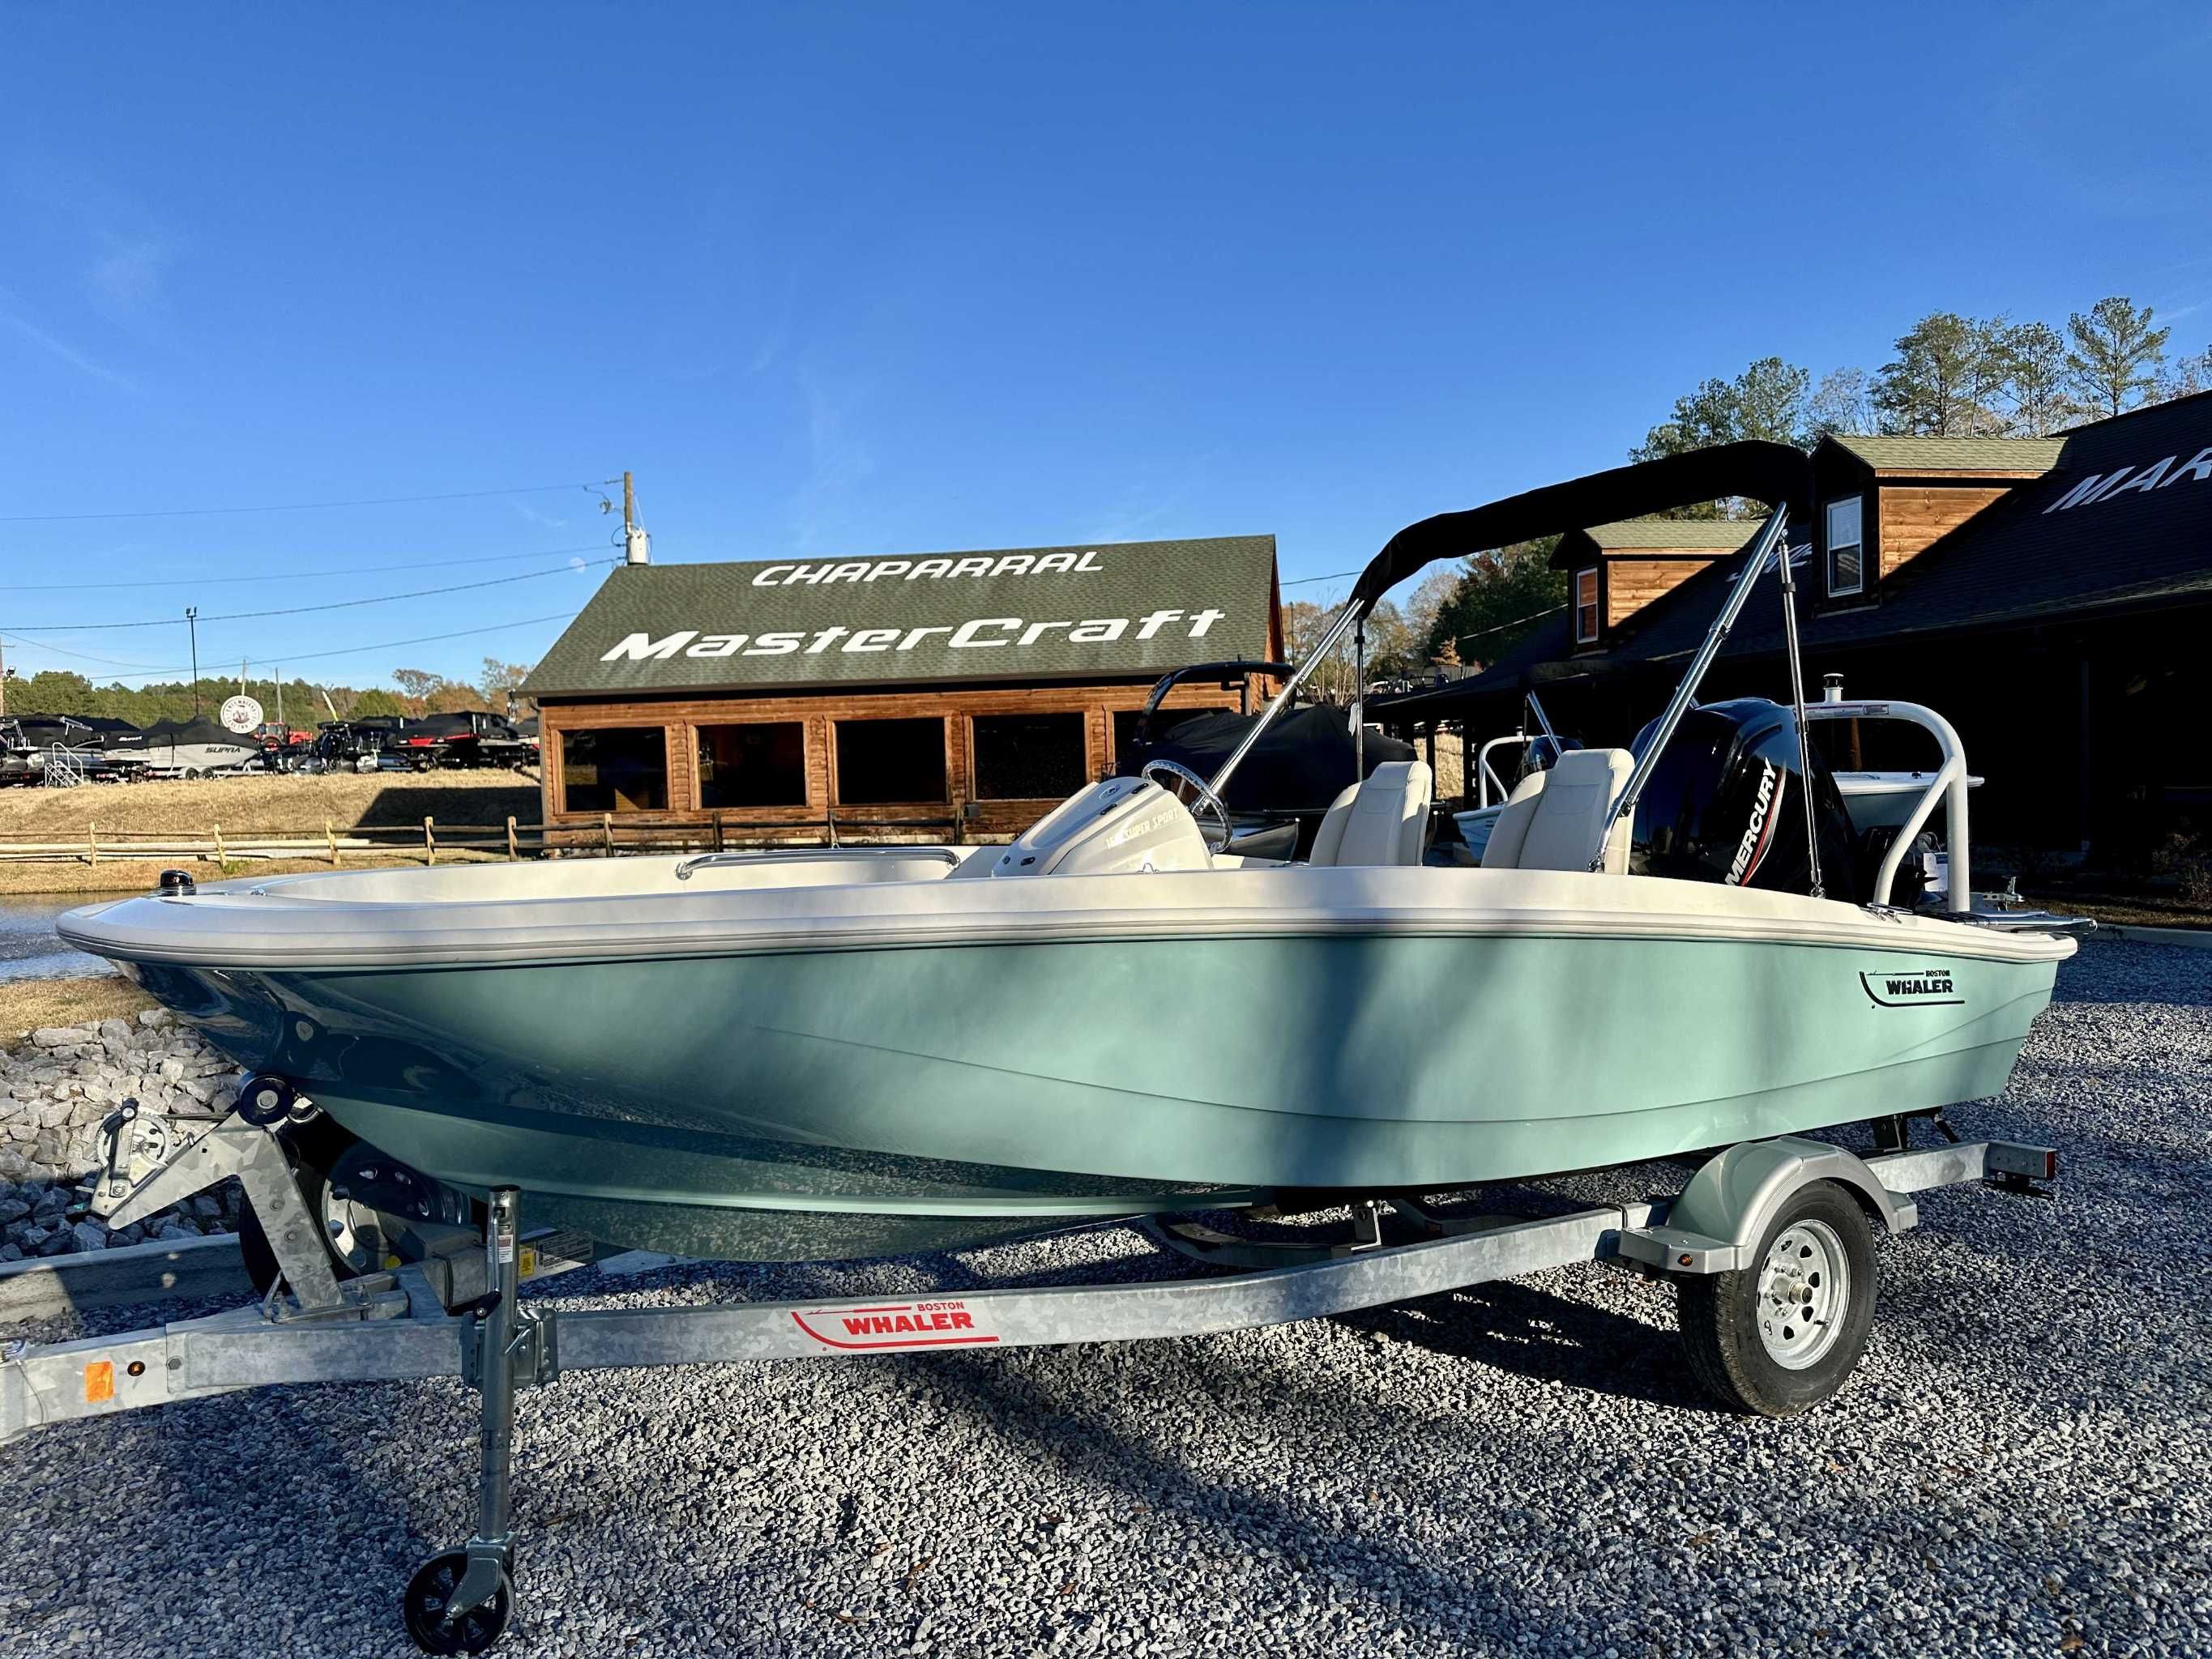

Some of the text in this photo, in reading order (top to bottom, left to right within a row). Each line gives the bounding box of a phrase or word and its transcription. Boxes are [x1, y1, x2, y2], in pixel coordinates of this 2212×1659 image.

[752, 551, 1104, 586] CHAPARRAL
[600, 609, 1226, 661] MasterCraft
[1123, 820, 1151, 840] SUPER
[1152, 808, 1179, 830] SPORT
[1725, 757, 1776, 886] MERCURY
[1885, 979, 1954, 995] WHALER
[917, 1301, 964, 1311] BOSTON
[842, 1312, 975, 1335] WHALER
